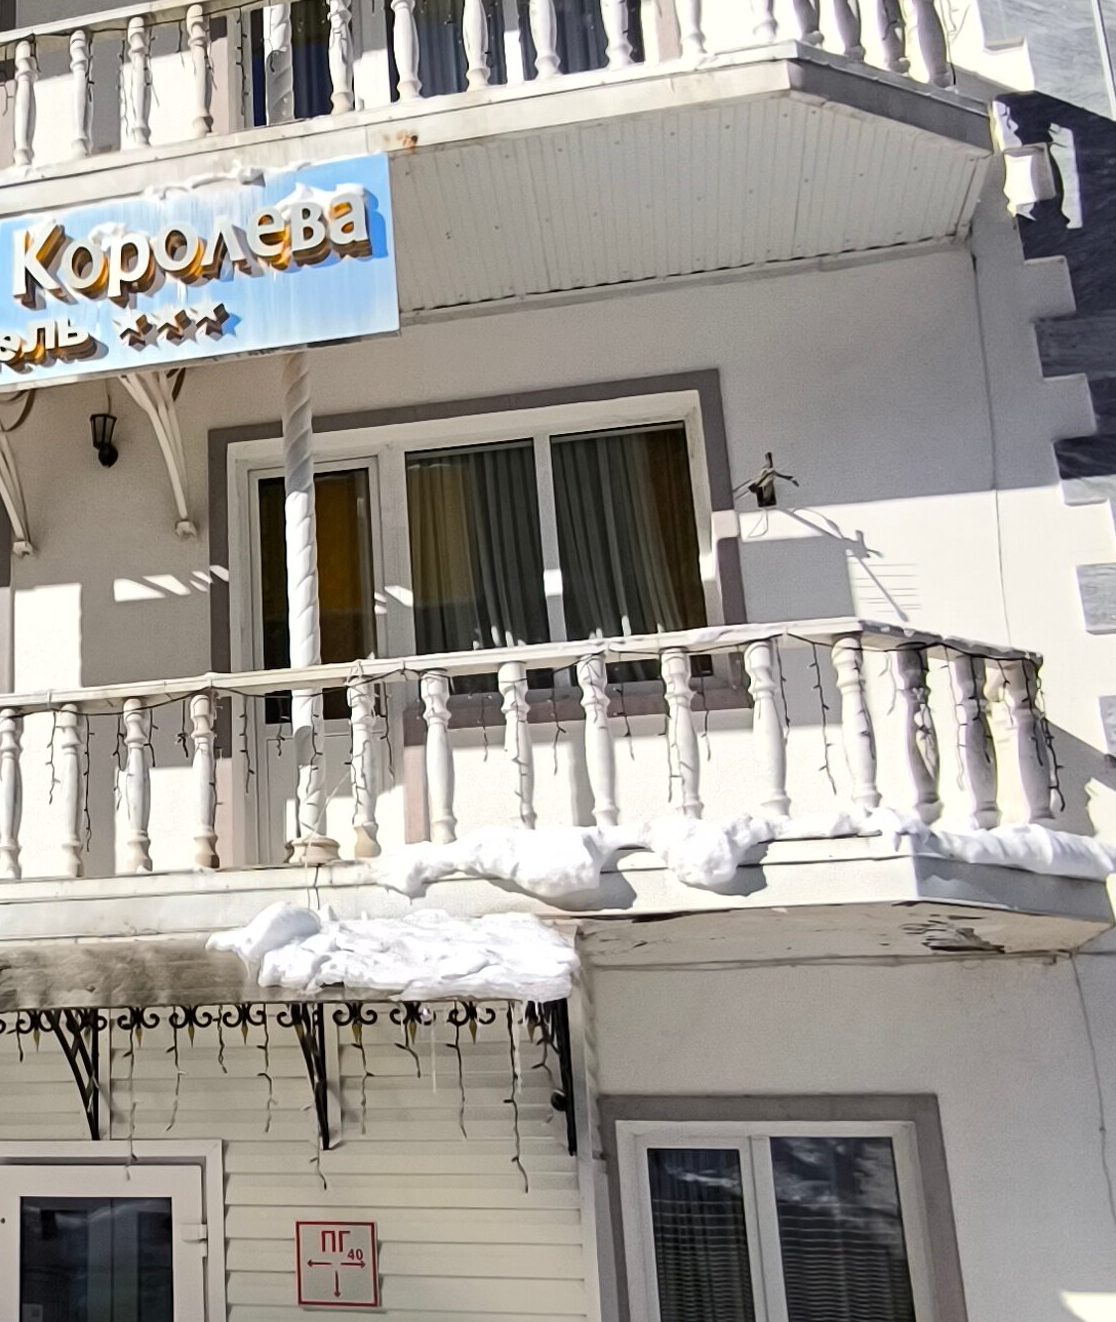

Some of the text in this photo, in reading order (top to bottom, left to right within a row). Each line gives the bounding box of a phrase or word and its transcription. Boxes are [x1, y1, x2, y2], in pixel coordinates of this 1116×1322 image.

[11, 190, 373, 303] Королева
[321, 1230, 351, 1253] ПГ
[347, 1248, 364, 1261] 40
